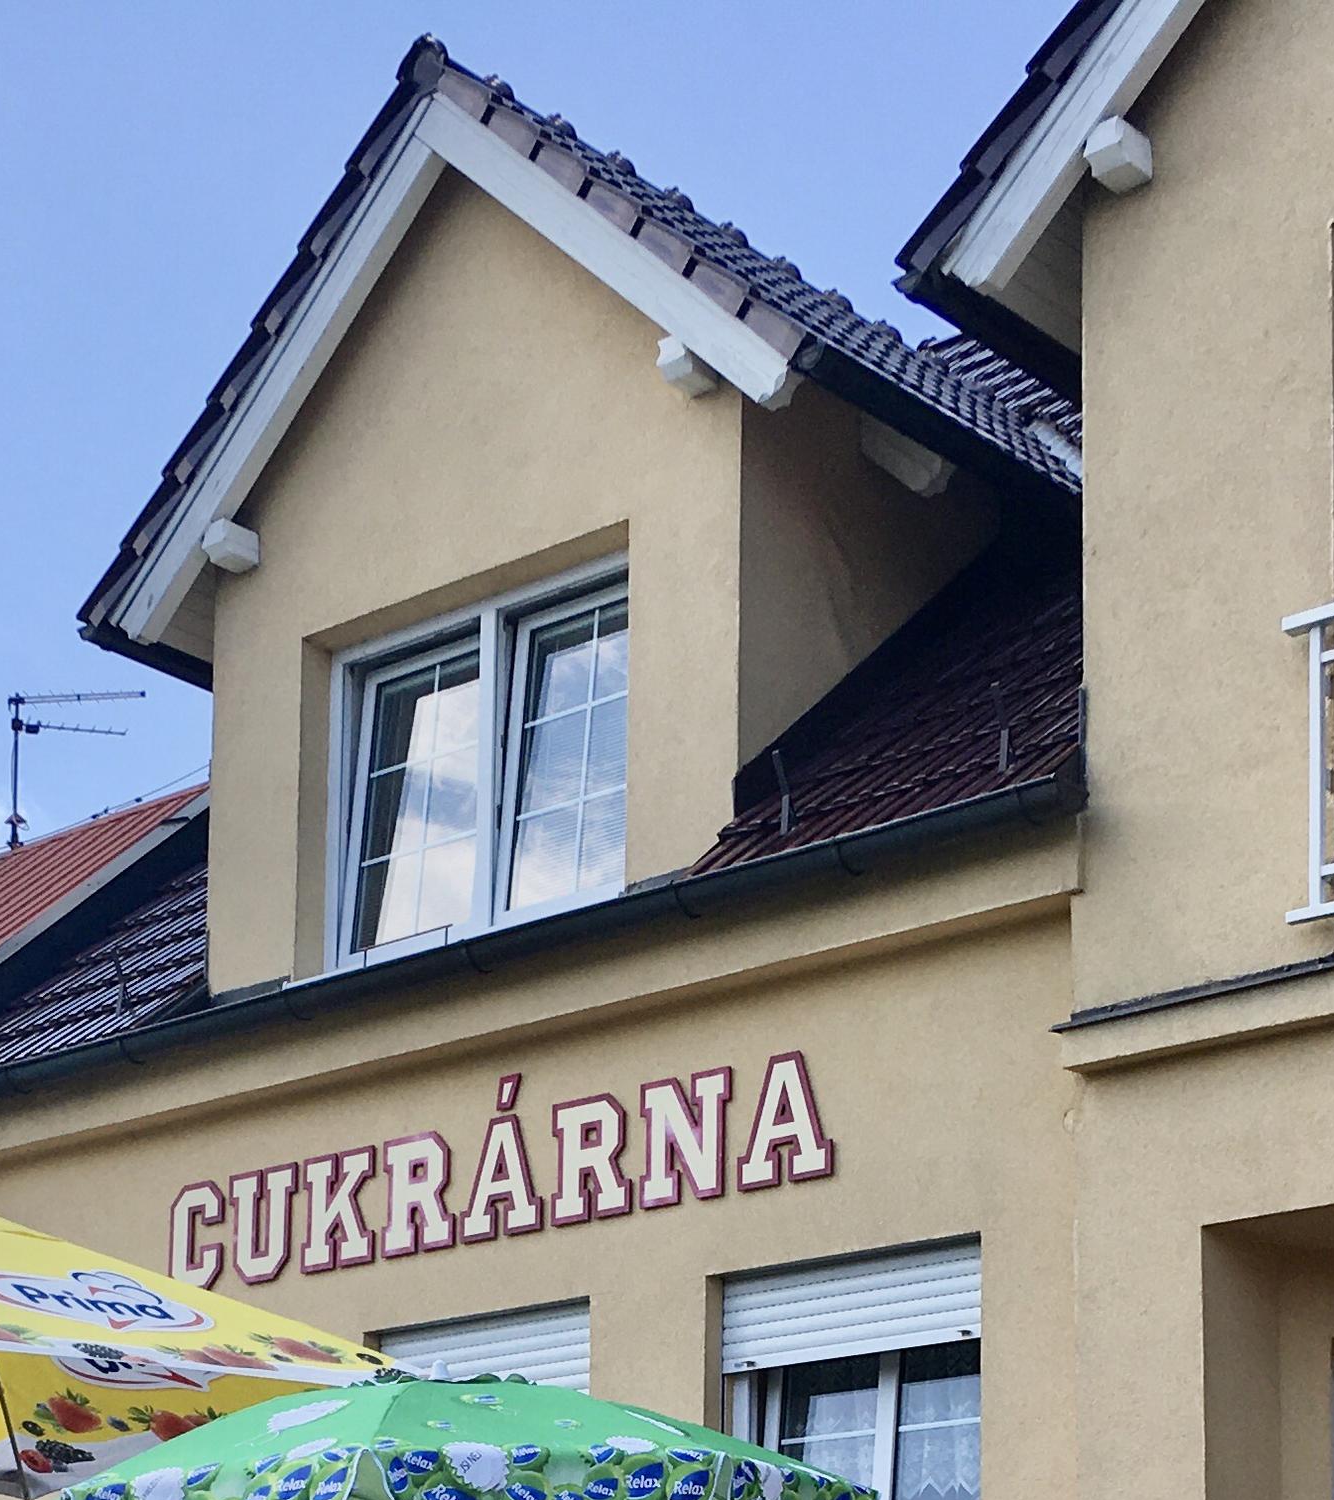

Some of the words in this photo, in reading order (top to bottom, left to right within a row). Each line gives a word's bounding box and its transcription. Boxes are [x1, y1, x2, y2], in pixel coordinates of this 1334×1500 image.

[171, 1050, 834, 1290] CUKRÁRNA
[11, 1283, 175, 1320] Prima
[403, 1450, 434, 1471] Relax
[276, 1477, 306, 1492] Relax
[587, 1481, 615, 1497] Relax
[626, 1474, 661, 1488] Relax
[674, 1480, 706, 1496] Relax
